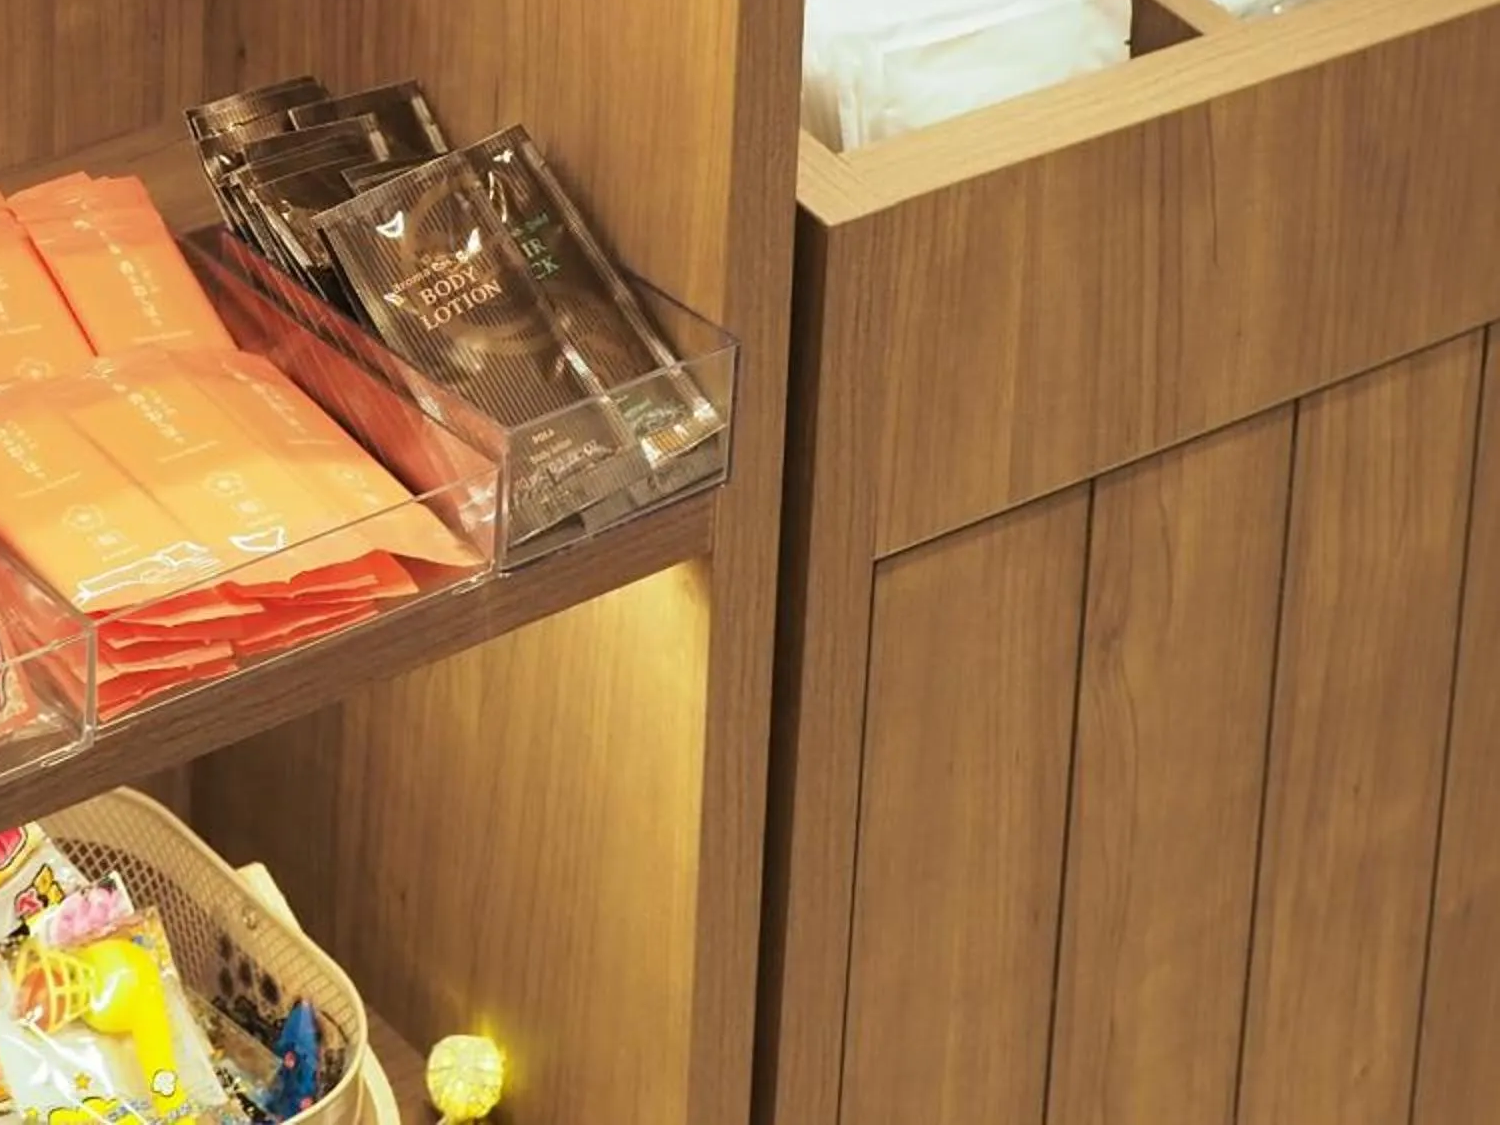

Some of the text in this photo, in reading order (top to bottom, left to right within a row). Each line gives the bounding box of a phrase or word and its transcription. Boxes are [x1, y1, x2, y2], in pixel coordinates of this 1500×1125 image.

[521, 238, 548, 258] IR
[530, 257, 560, 280] CK
[420, 266, 478, 305] BODY
[420, 279, 502, 331] LOTION
